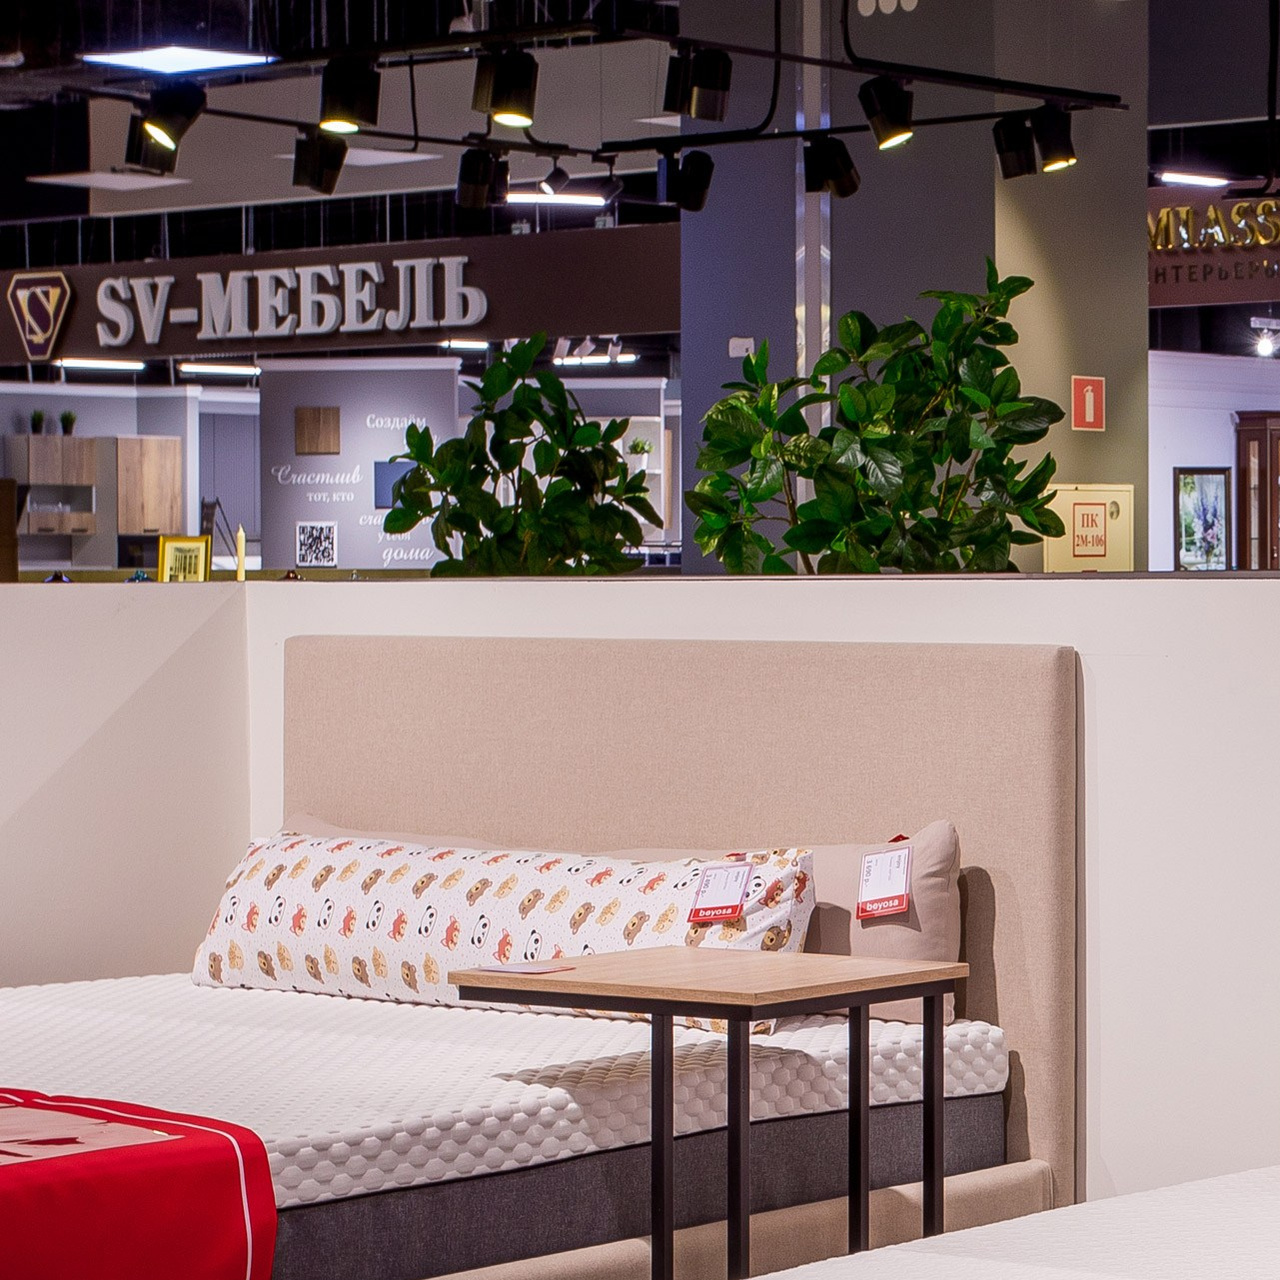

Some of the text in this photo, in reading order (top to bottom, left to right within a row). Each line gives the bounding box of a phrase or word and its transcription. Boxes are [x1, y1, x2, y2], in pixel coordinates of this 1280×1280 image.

[96, 256, 488, 349] SV-МЕБЕЛЬ
[270, 463, 364, 486] Счастлив
[332, 491, 355, 502] кто
[1081, 512, 1099, 528] ПК
[1075, 533, 1105, 548] 2М-106
[382, 546, 434, 568] дома
[866, 899, 899, 911] beyosa
[699, 908, 732, 918] beyosa
